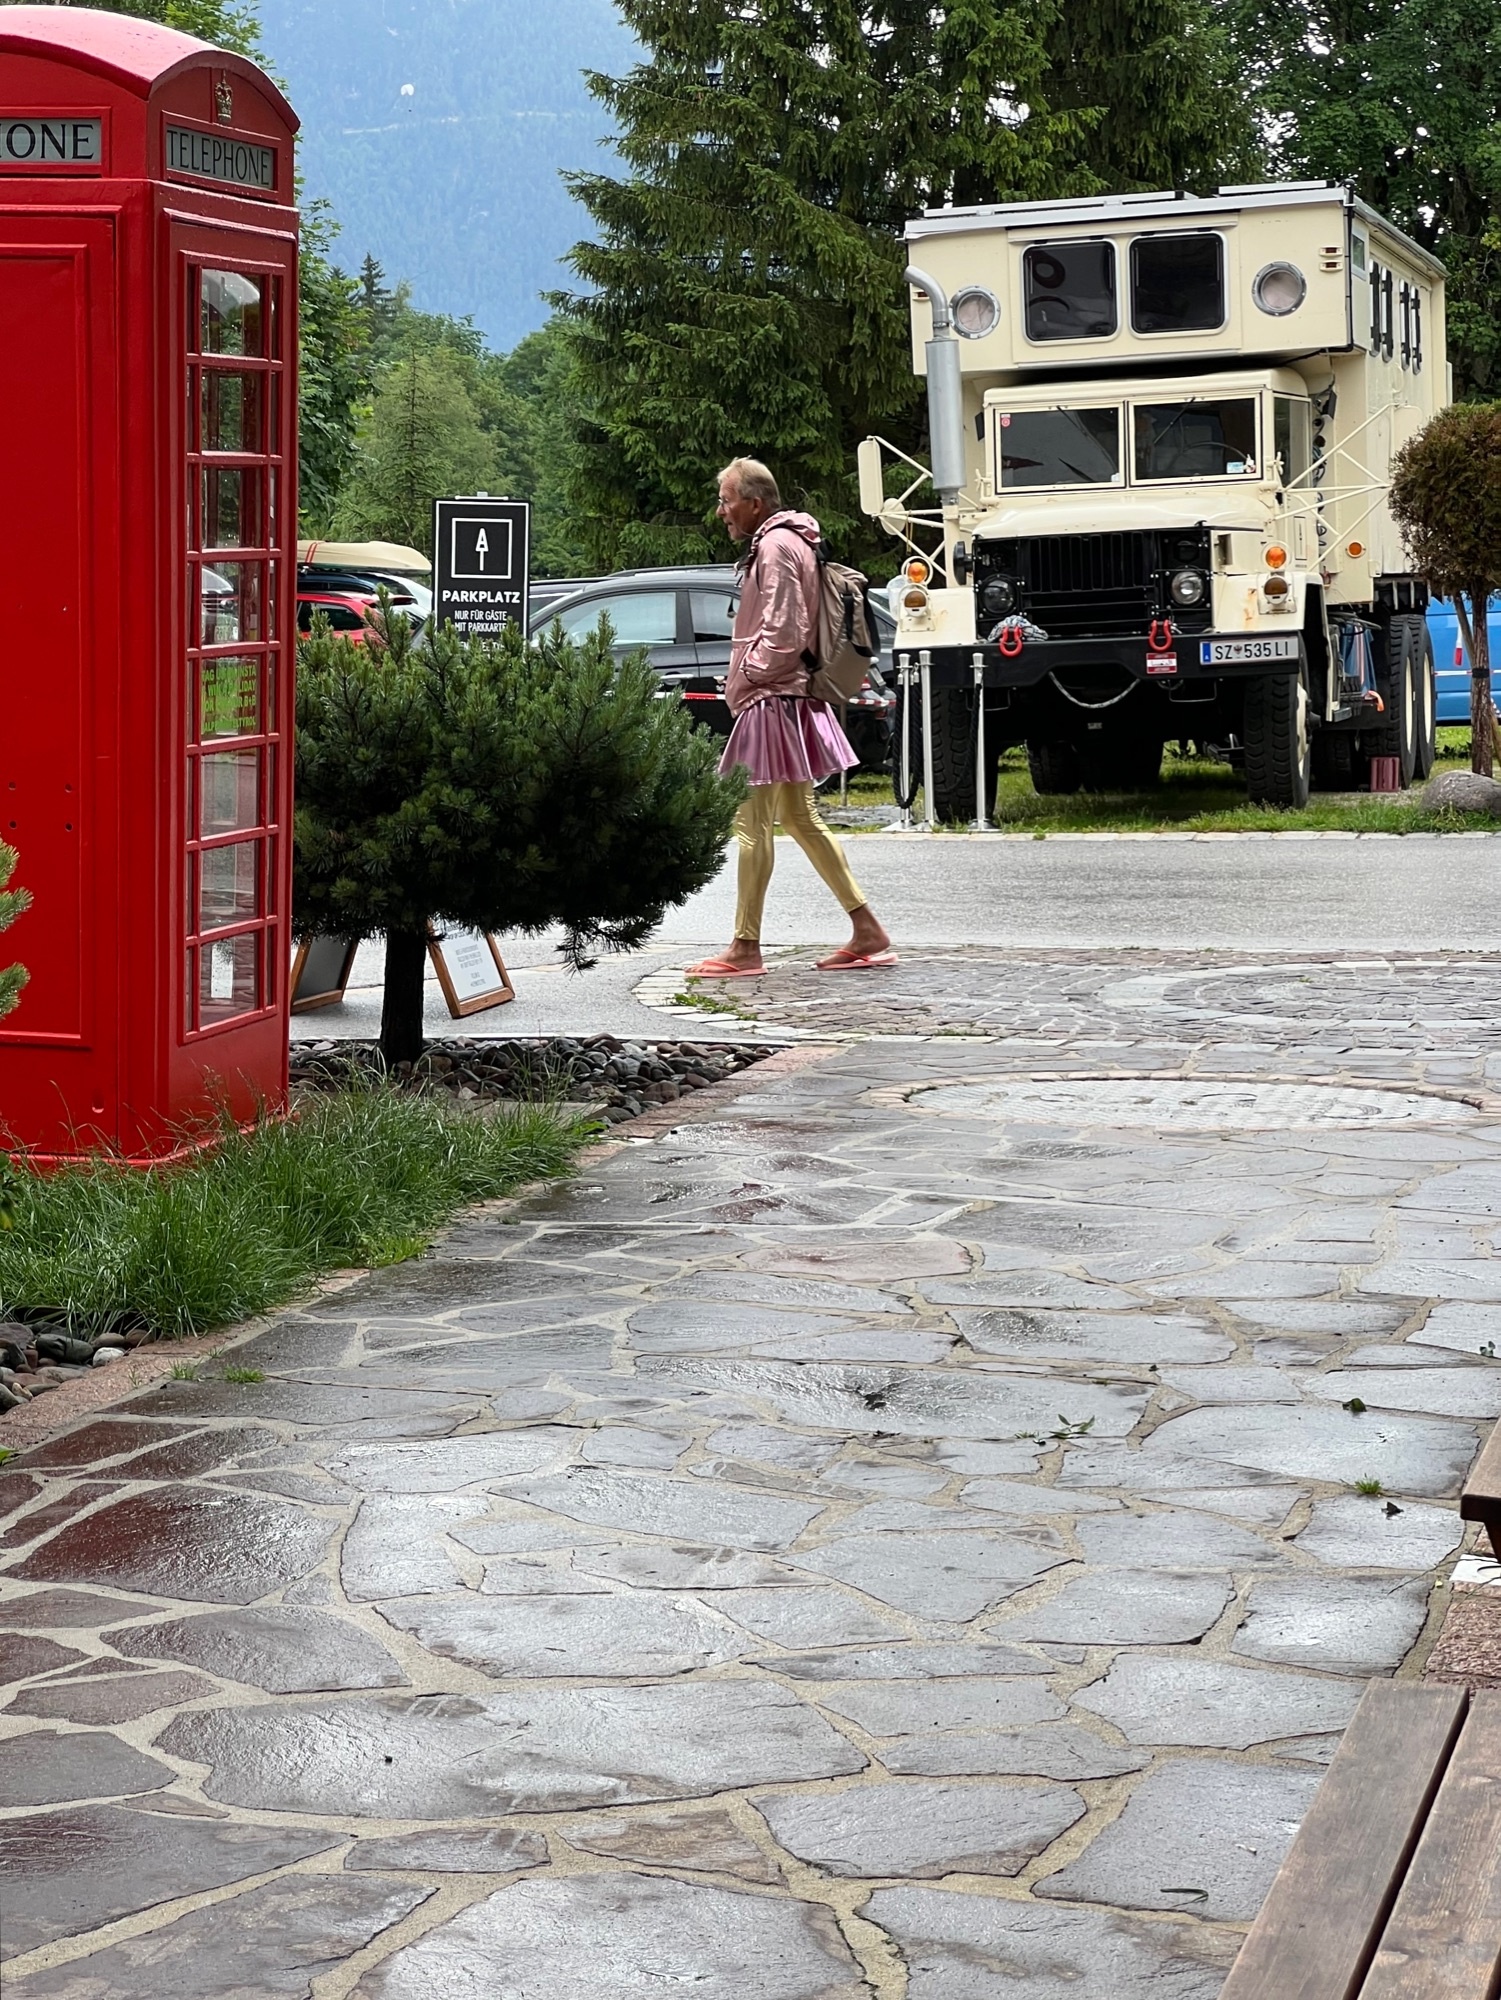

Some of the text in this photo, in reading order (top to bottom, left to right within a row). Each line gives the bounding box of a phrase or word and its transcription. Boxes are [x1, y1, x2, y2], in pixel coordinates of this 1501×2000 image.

[0, 123, 94, 159] ONE
[167, 129, 269, 185] TELEPHONE
[442, 590, 520, 603] PARKPLATZ
[454, 608, 507, 621] NUR FÜR GÄSTE
[454, 622, 507, 632] MIT PARKKARTE
[1215, 644, 1232, 660] SZ
[1244, 642, 1271, 658] 535
[1275, 641, 1288, 657] LI
